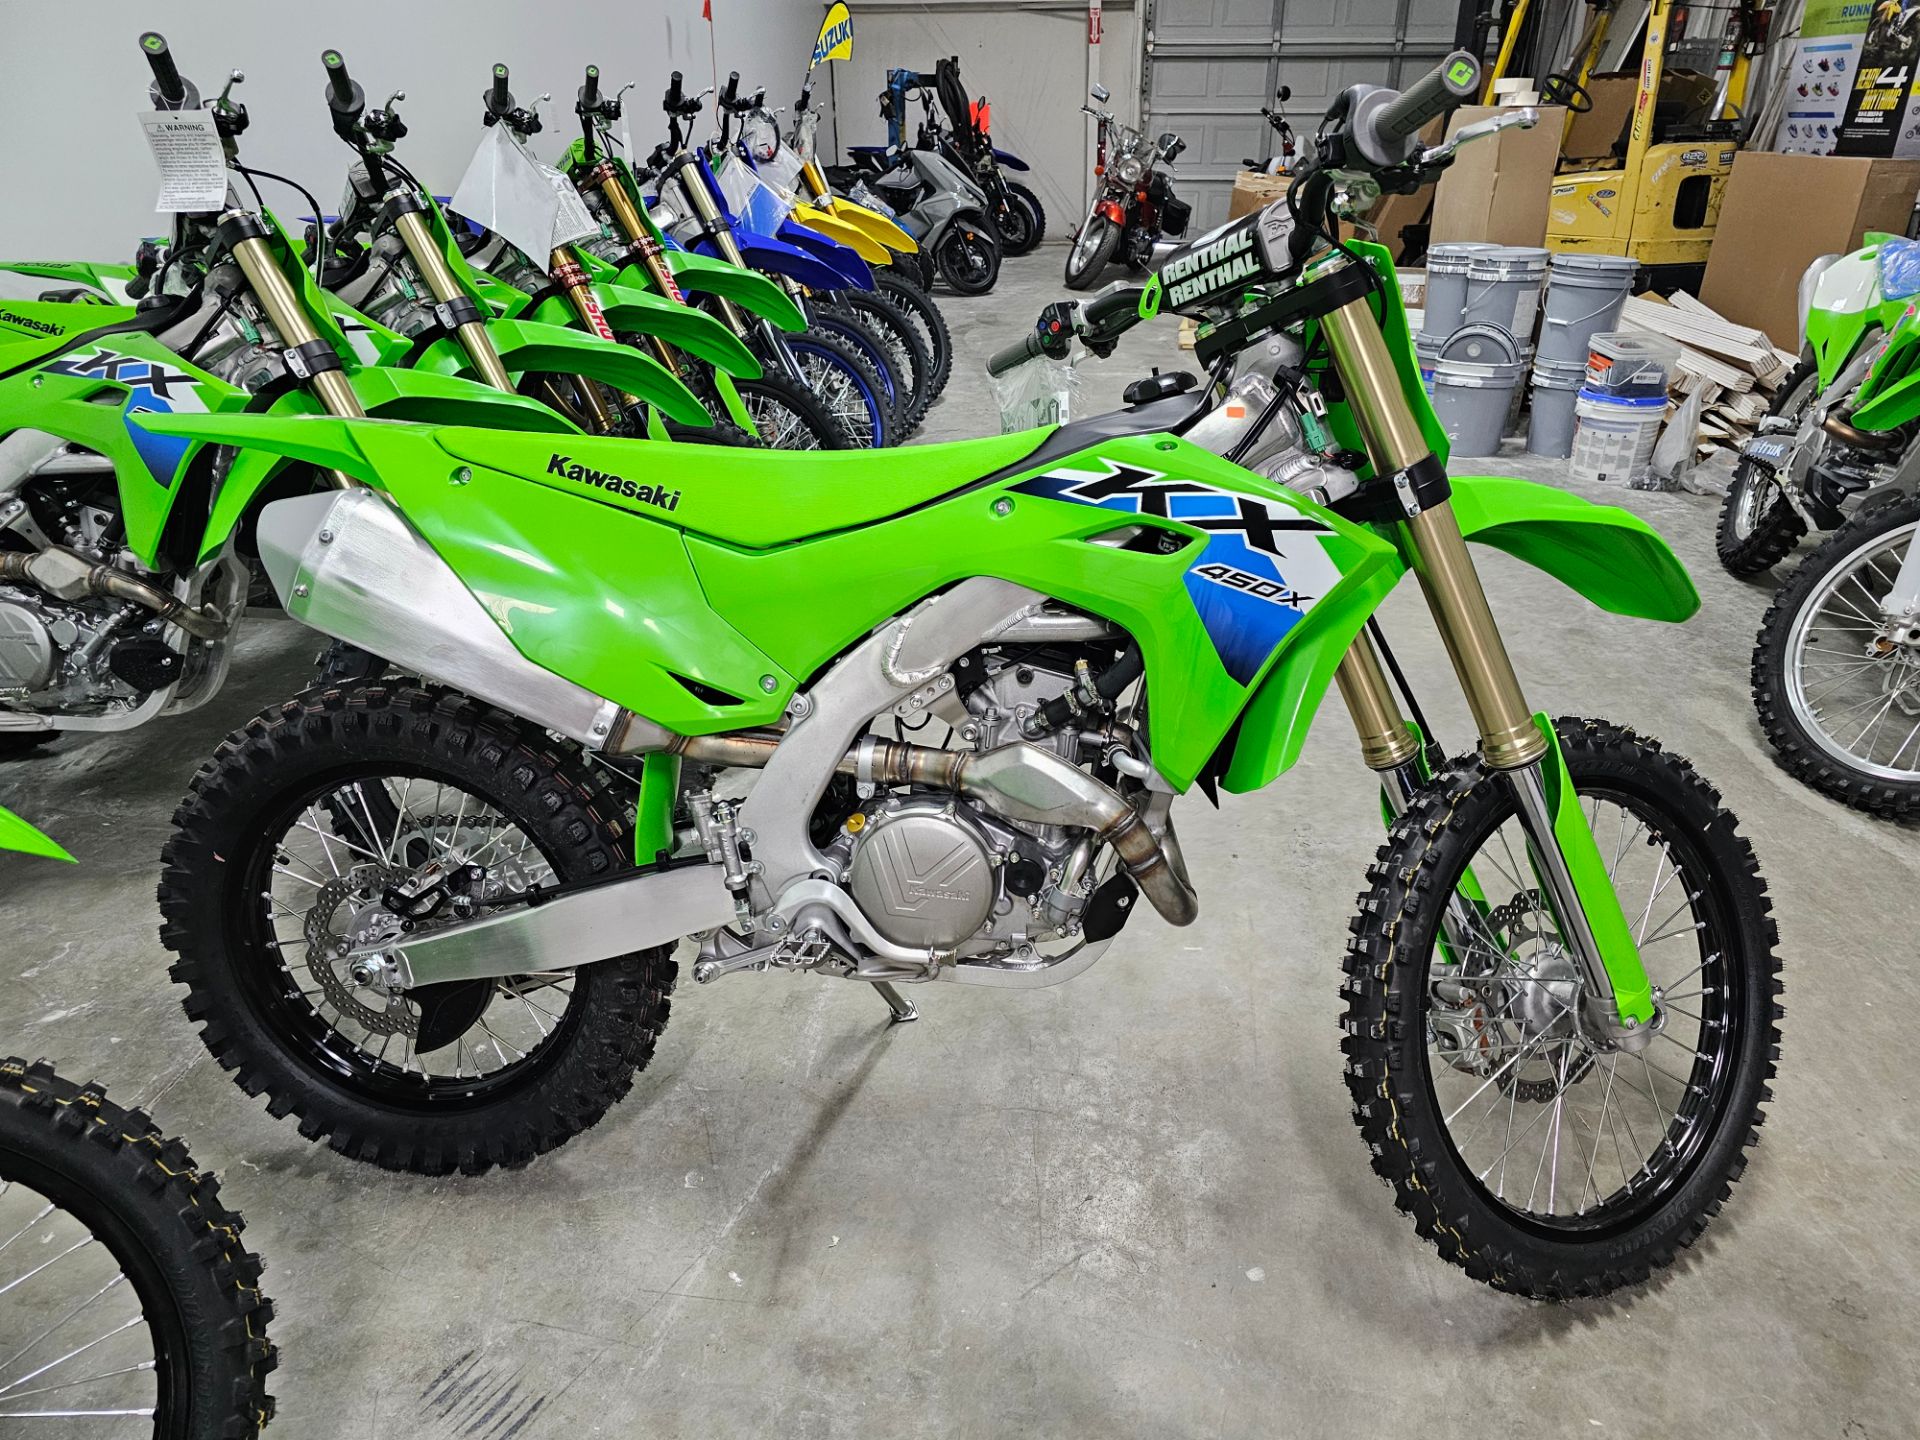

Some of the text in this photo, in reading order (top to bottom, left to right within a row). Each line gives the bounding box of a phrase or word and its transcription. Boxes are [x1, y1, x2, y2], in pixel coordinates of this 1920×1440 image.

[813, 17, 853, 65] SUZUKI
[1876, 65, 1908, 88] 4
[165, 124, 205, 132] WARNING
[1163, 227, 1253, 286] RENTHAL
[1168, 251, 1261, 307] RENTHAL
[72, 349, 200, 401] KX
[547, 453, 681, 512] Kawasaki
[1066, 463, 1337, 560] KX
[1198, 564, 1316, 609] 450X
